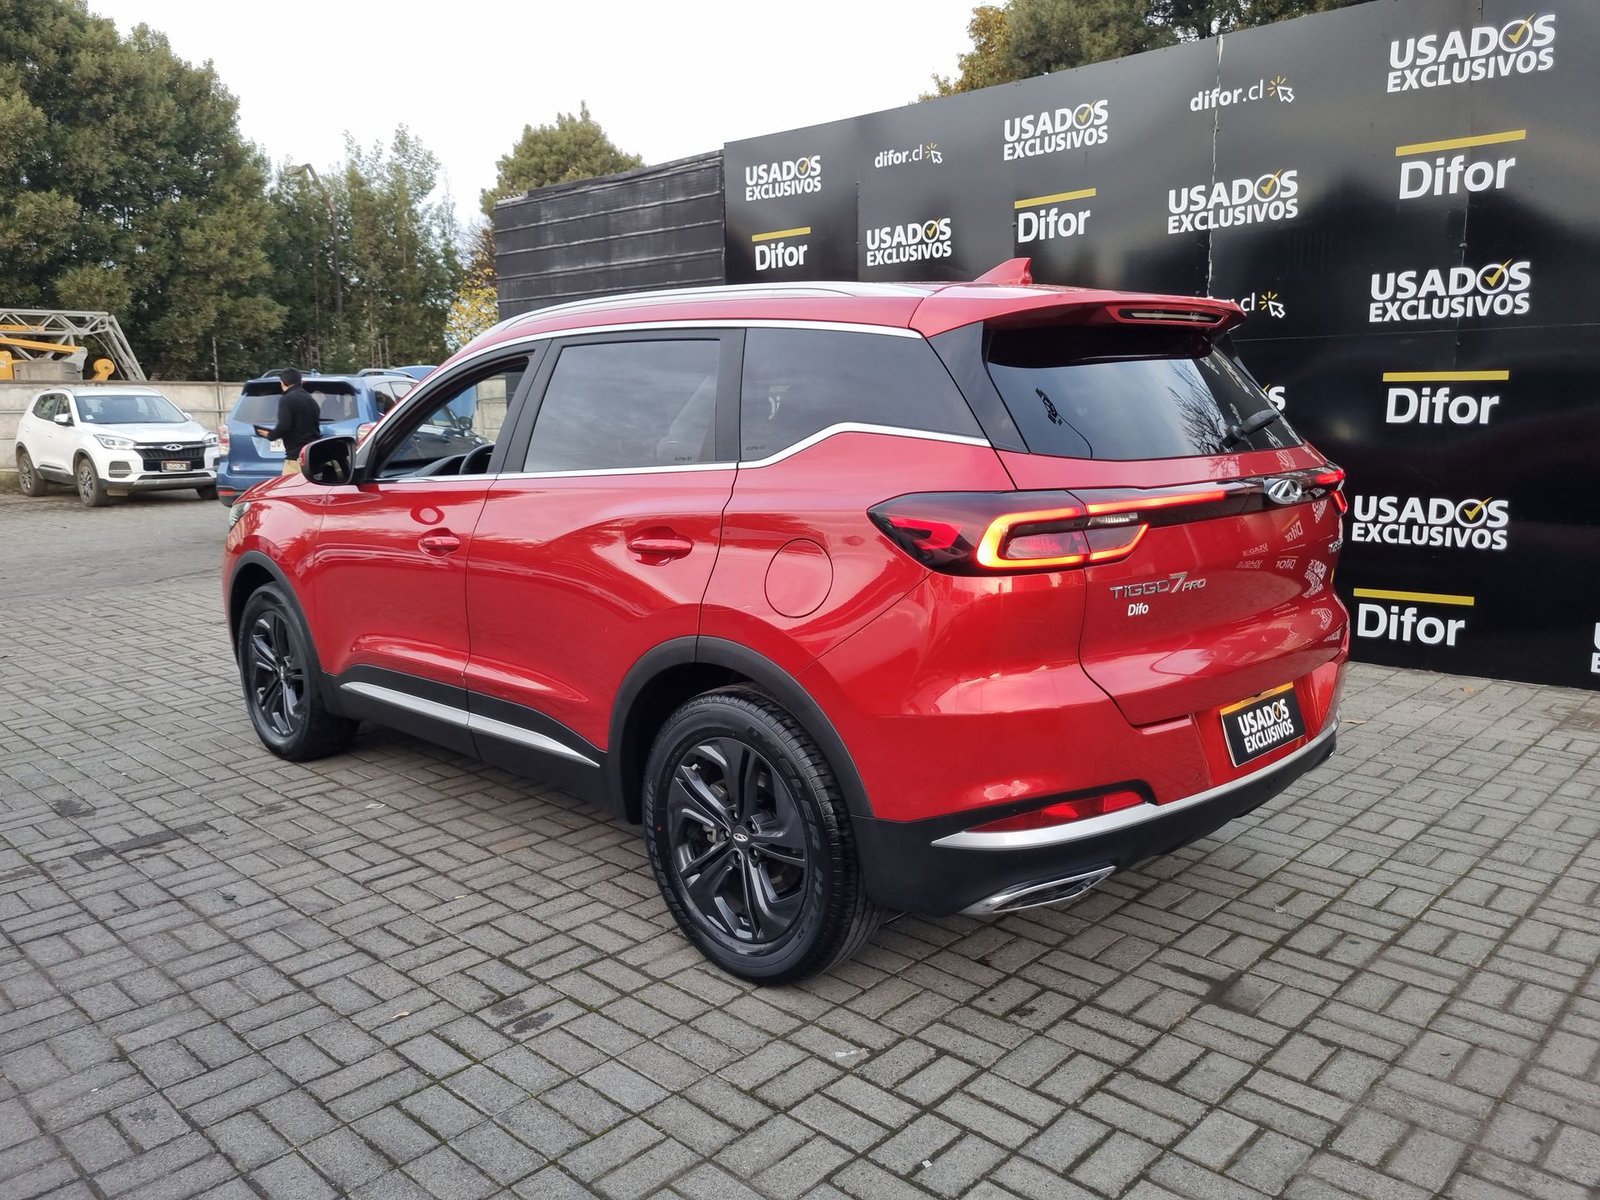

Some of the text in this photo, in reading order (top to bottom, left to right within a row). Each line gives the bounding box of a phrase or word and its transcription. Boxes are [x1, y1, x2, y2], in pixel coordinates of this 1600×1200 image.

[1389, 14, 1556, 69] USADOS
[1387, 47, 1554, 93] EXCLUSIVOS
[1190, 79, 1264, 112] difor.cl
[1004, 100, 1108, 142] USADOS
[874, 144, 923, 168] difor.cl
[1003, 126, 1108, 161] EXCLUSIVOS
[745, 155, 821, 187] USADOS
[745, 176, 822, 201] EXCLUSIVOS
[1399, 155, 1516, 200] Difor
[1168, 170, 1298, 214] USADOS
[1018, 207, 1091, 243] Difor
[1168, 199, 1298, 234] EXCLUSIVOS
[866, 218, 952, 251] USADOS
[755, 242, 808, 271] Difor
[866, 241, 952, 266] EXCLUSIVOS
[1370, 261, 1531, 301] USADOS
[1369, 293, 1530, 323] EXCLUSIVOS
[1385, 387, 1500, 424] Difor
[1353, 495, 1509, 528] USADOS
[1351, 522, 1508, 551] EXCLUSIVOS
[1128, 602, 1149, 617] Difo
[1357, 603, 1465, 646] Difor
[1237, 698, 1290, 736] USADOS
[1243, 718, 1295, 753] EXCLUSIVOS
